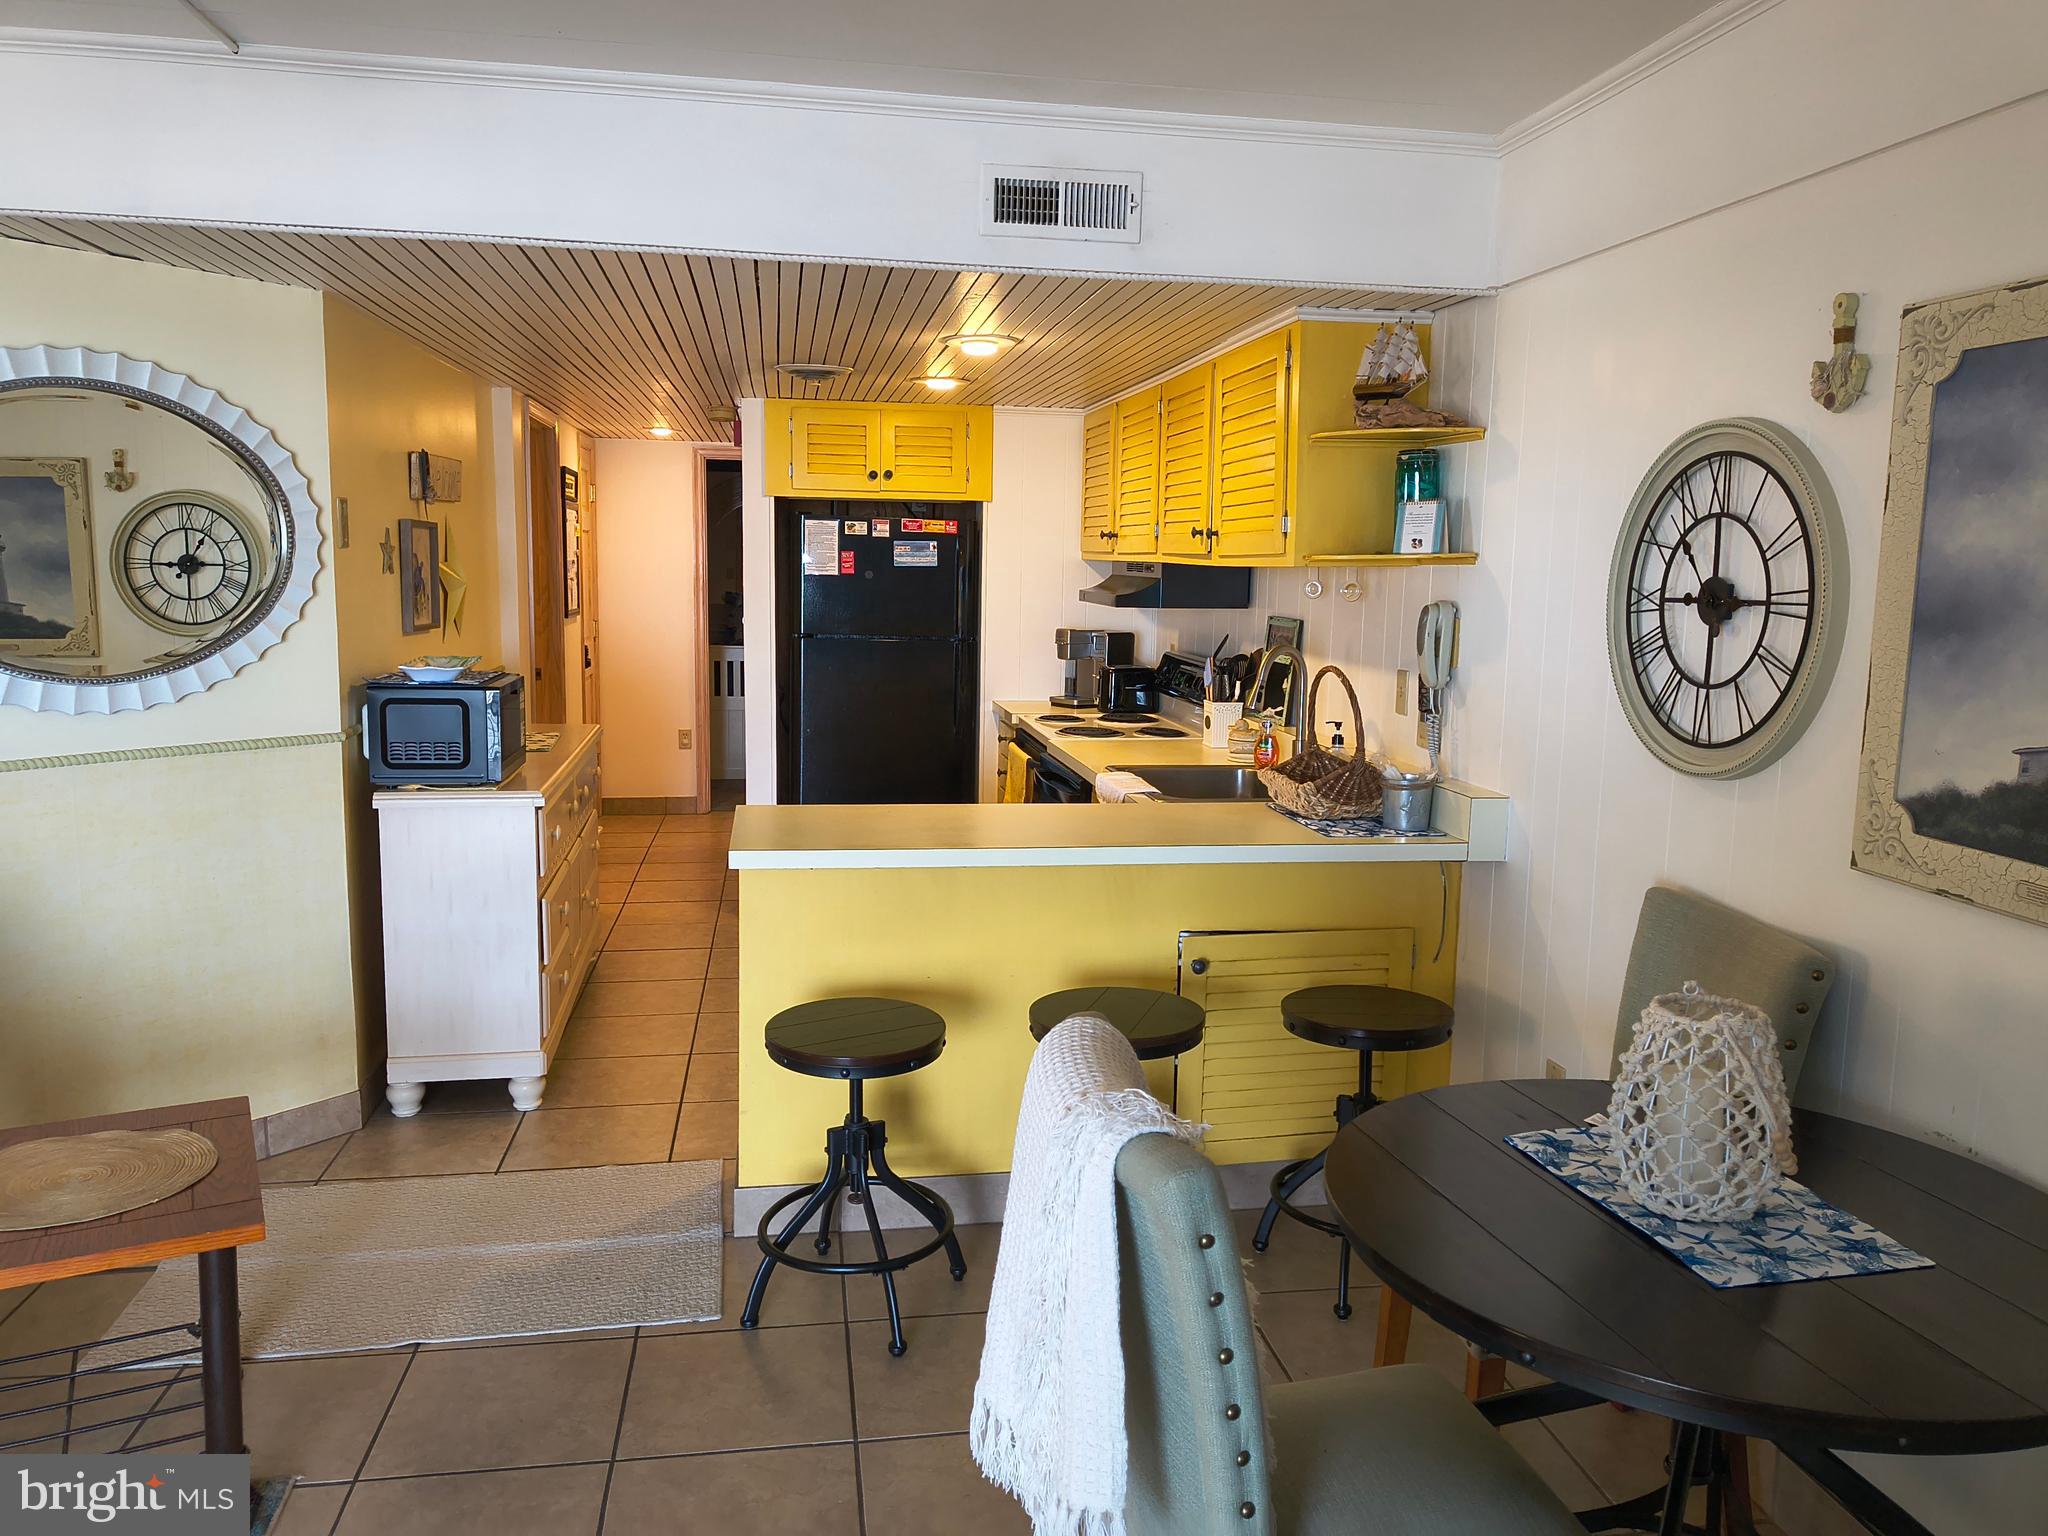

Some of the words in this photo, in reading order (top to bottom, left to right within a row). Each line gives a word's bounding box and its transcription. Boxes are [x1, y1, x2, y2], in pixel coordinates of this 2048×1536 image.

[1708, 455, 1732, 514] XII
[1643, 524, 1673, 564] X
[1769, 589, 1809, 620] III
